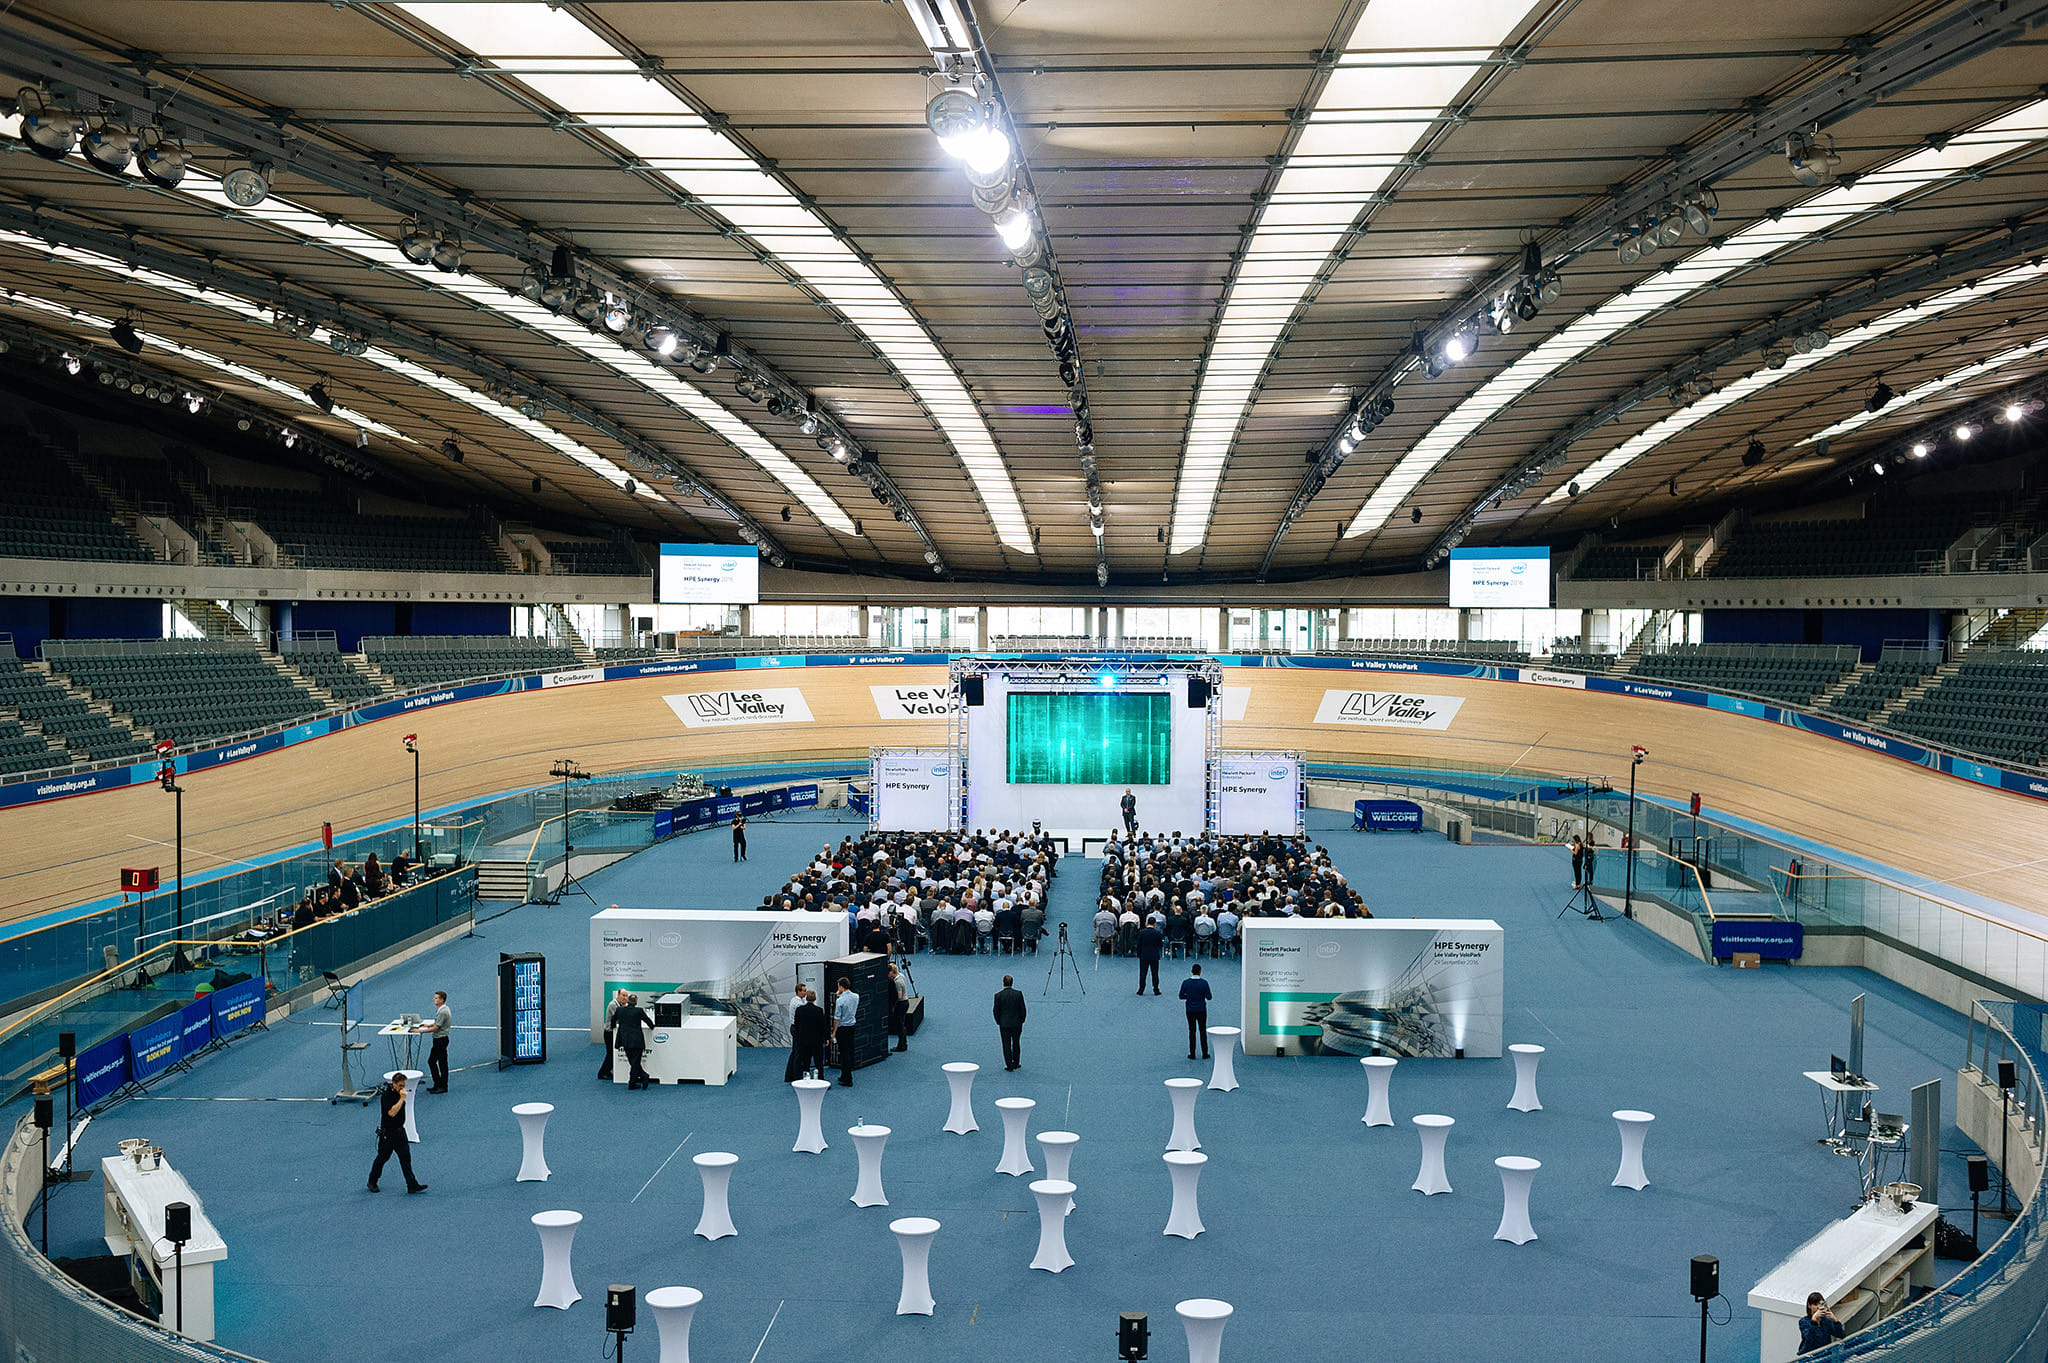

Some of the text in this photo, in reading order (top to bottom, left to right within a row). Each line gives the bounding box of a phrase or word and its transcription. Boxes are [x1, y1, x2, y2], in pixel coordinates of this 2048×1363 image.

[639, 663, 698, 675] visitleevalley.org.uk
[1351, 660, 1418, 671] Lee Valley VeloPark
[404, 690, 455, 709] Lee Valley VeloPark
[730, 692, 763, 703] Lee
[895, 688, 929, 701] Lee
[1391, 694, 1425, 707] Lee
[735, 702, 785, 715] Valley
[1387, 706, 1437, 722] Valley
[1842, 728, 1887, 750] Lee Valley VeloPark
[36, 777, 97, 795] visitleevalley.org.uk
[902, 782, 930, 791] Synergy
[1238, 786, 1267, 794] Synergy
[1371, 814, 1418, 822] WELCOME
[132, 871, 140, 887] 0
[773, 933, 827, 943] HPE Synergy
[1720, 936, 1794, 945] visitleevalley.org.uk
[1434, 941, 1490, 951] HPE Synergy
